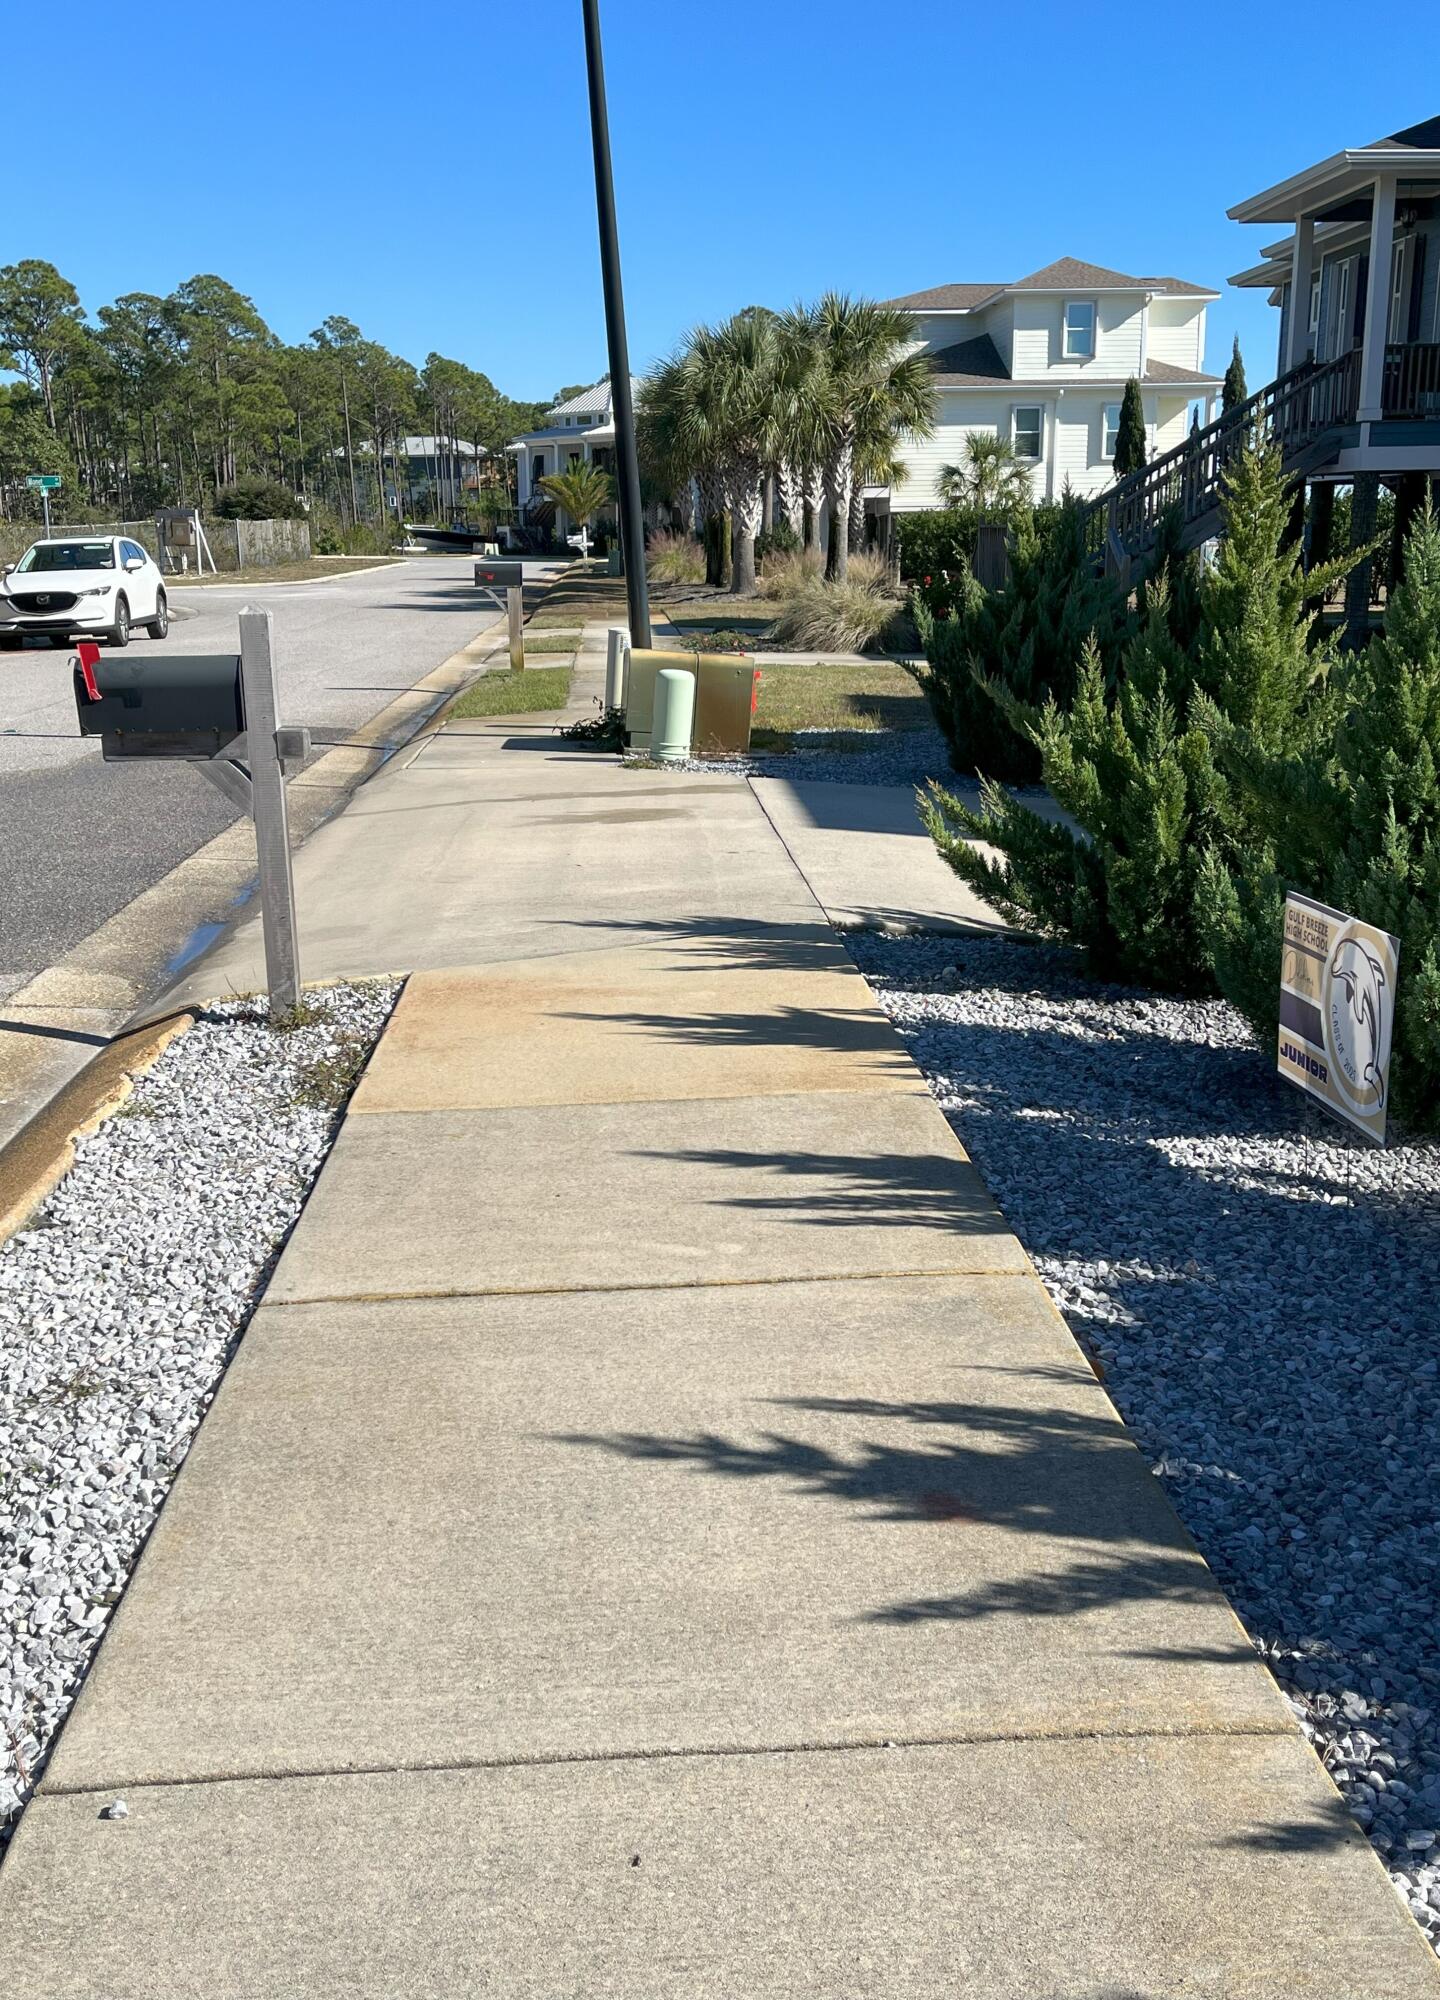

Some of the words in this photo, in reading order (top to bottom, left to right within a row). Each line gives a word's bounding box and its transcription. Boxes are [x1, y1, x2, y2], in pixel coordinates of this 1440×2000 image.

[1285, 921, 1303, 940] HIGH
[1303, 929, 1329, 953] SCHOOL
[1288, 909, 1305, 926] GULF
[1305, 916, 1329, 938] BREEZE
[1279, 1042, 1328, 1085] JUNIOR
